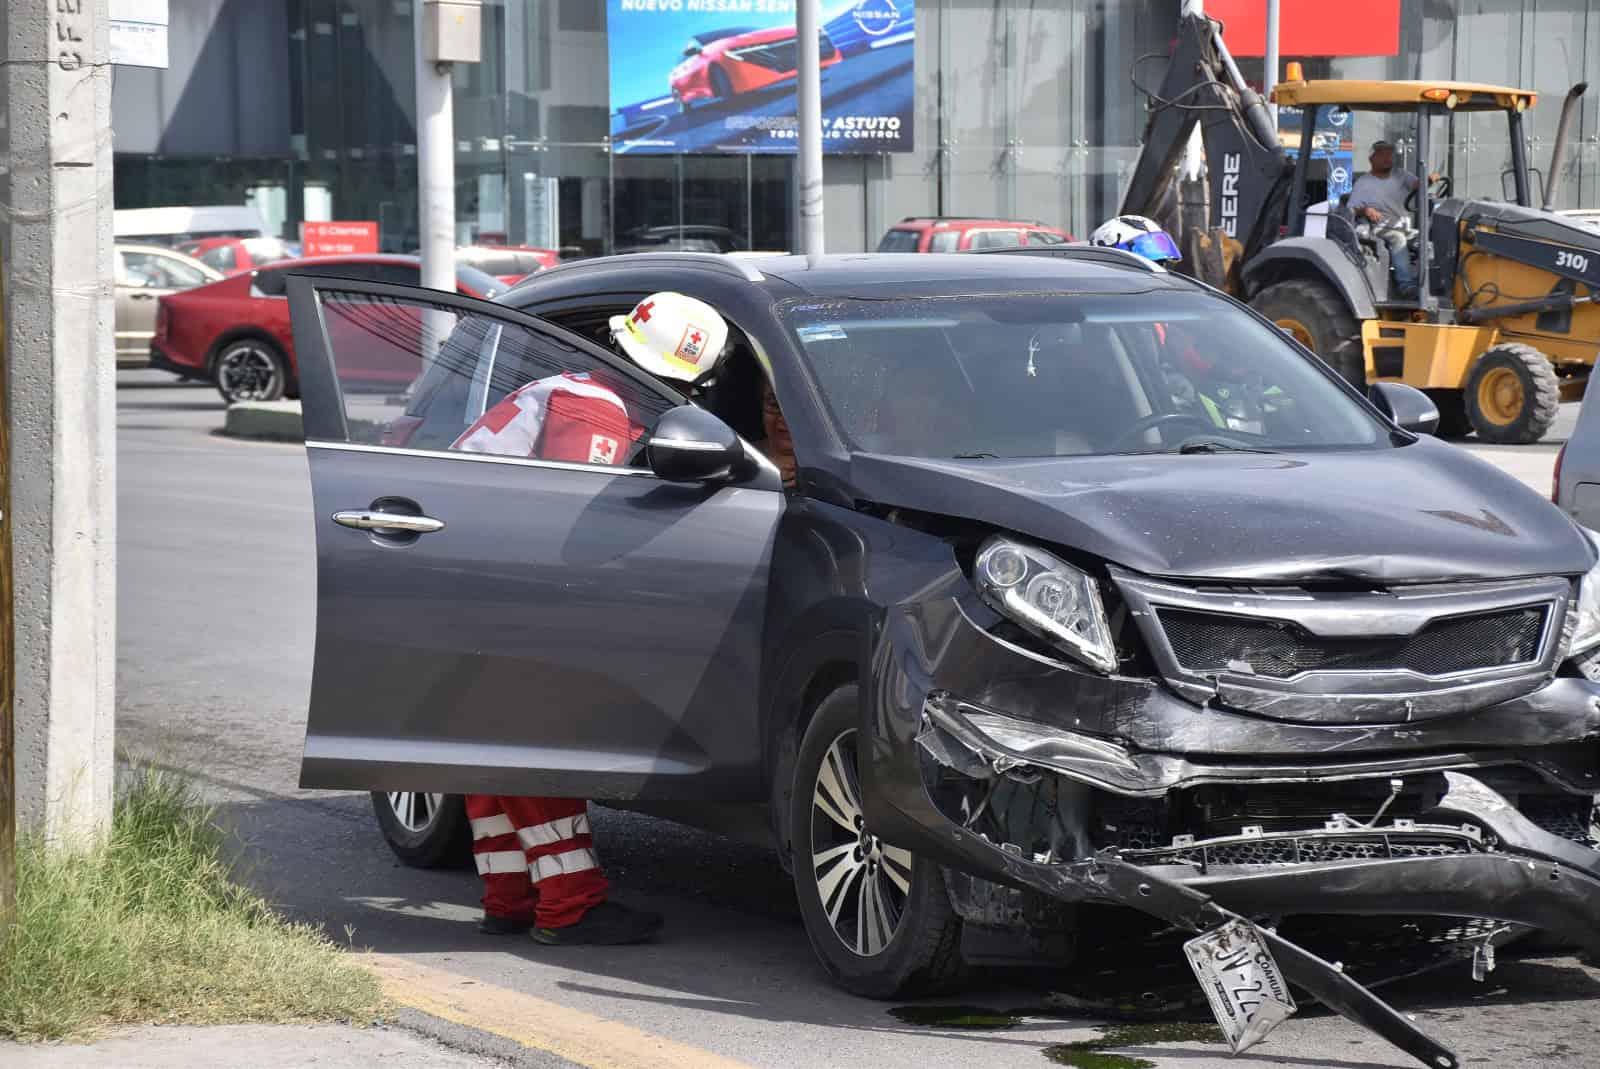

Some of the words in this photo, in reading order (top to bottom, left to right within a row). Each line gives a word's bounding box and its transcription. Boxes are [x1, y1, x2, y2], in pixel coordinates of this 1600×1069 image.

[621, 0, 683, 11] NUEVO
[687, 0, 754, 12] NISSAN
[755, 0, 797, 13] SEN
[852, 10, 901, 19] NISSAN
[832, 116, 901, 130] ASTUTO
[844, 130, 901, 139] CONTROL
[1221, 153, 1241, 237] EERE
